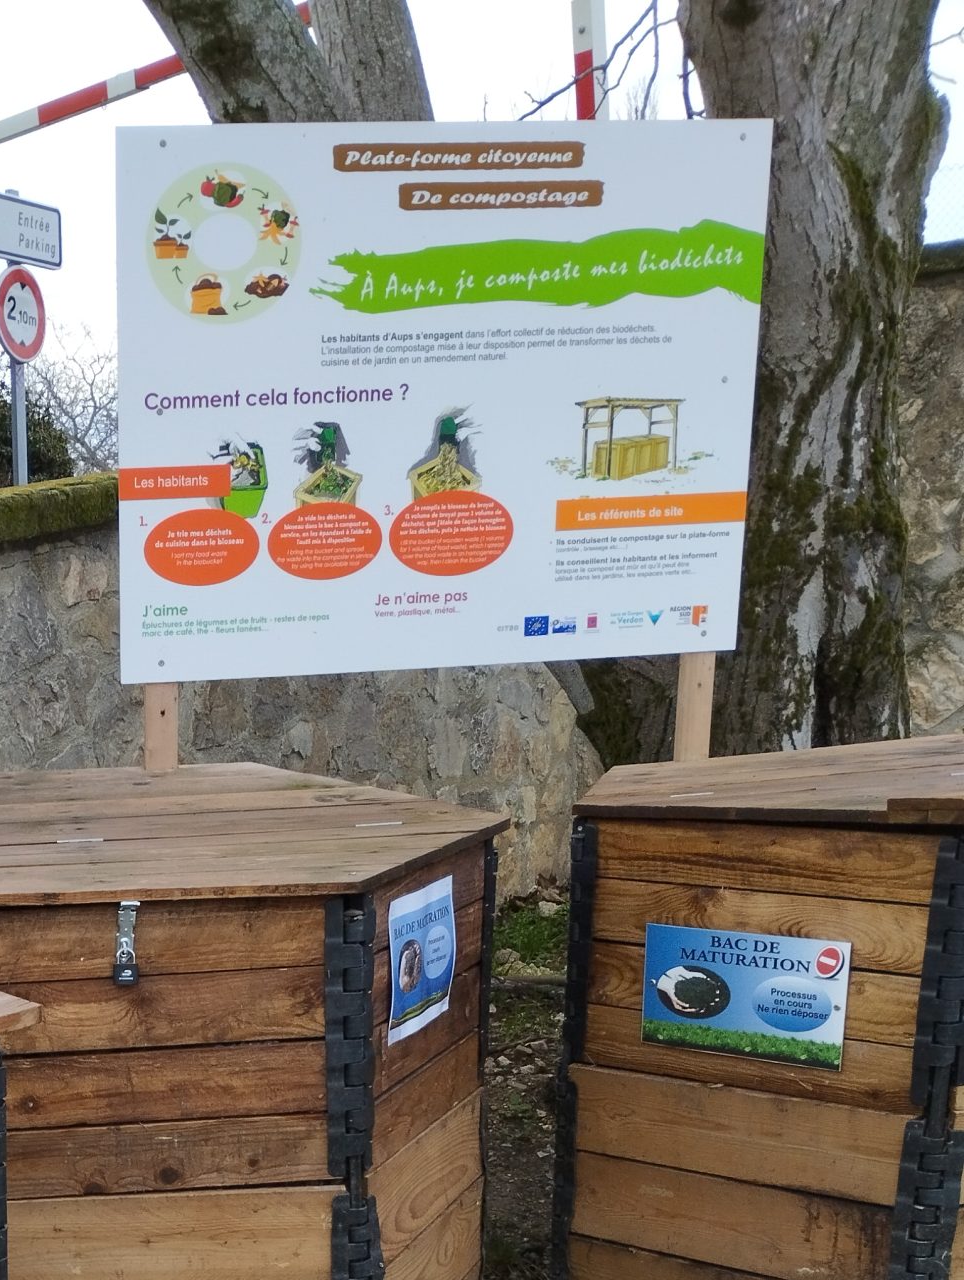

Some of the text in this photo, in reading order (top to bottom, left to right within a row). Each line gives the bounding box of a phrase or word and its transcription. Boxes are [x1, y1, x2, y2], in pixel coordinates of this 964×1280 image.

[345, 149, 573, 167] Plate-forme citoyenne
[411, 189, 588, 206] De compostage
[18, 212, 50, 232] Entrée
[19, 233, 56, 258] Parking
[361, 244, 743, 303] À Aups, je composte mes biodéchets
[321, 335, 337, 343] Les
[340, 333, 380, 343] habitants
[383, 332, 413, 342] d'Aups
[416, 331, 463, 341] s'engagent
[465, 330, 485, 339] dans
[514, 327, 544, 336] collectif
[546, 326, 555, 335] de
[558, 325, 593, 335] réduction
[596, 325, 610, 334] des
[321, 335, 672, 355] L'installation de compostage mise à leur disposition permet de transformer les déchets de
[321, 357, 349, 367] cuisine
[352, 357, 359, 365] et
[362, 356, 372, 365] de
[374, 355, 396, 367] jardin
[424, 354, 476, 362] amendement
[144, 383, 409, 410] Comment cela fonctionne ?
[134, 474, 208, 488] Les habitants
[385, 505, 394, 516] 3.
[578, 506, 683, 521] Les référents de site
[140, 516, 148, 526] 1.
[262, 513, 271, 524] 2.
[168, 530, 175, 538] Je
[206, 528, 231, 536] déchets
[619, 534, 664, 542] compostage
[375, 592, 468, 606] Je n'aime pas
[143, 604, 188, 617] J'aime
[394, 924, 405, 940] BAC
[406, 921, 415, 934] DE
[710, 936, 780, 954] BAC DE
[680, 948, 811, 973] MATURATION
[771, 988, 817, 1000] Processus
[774, 998, 812, 1009] en cours
[757, 1004, 829, 1020] Ne rien déposer
